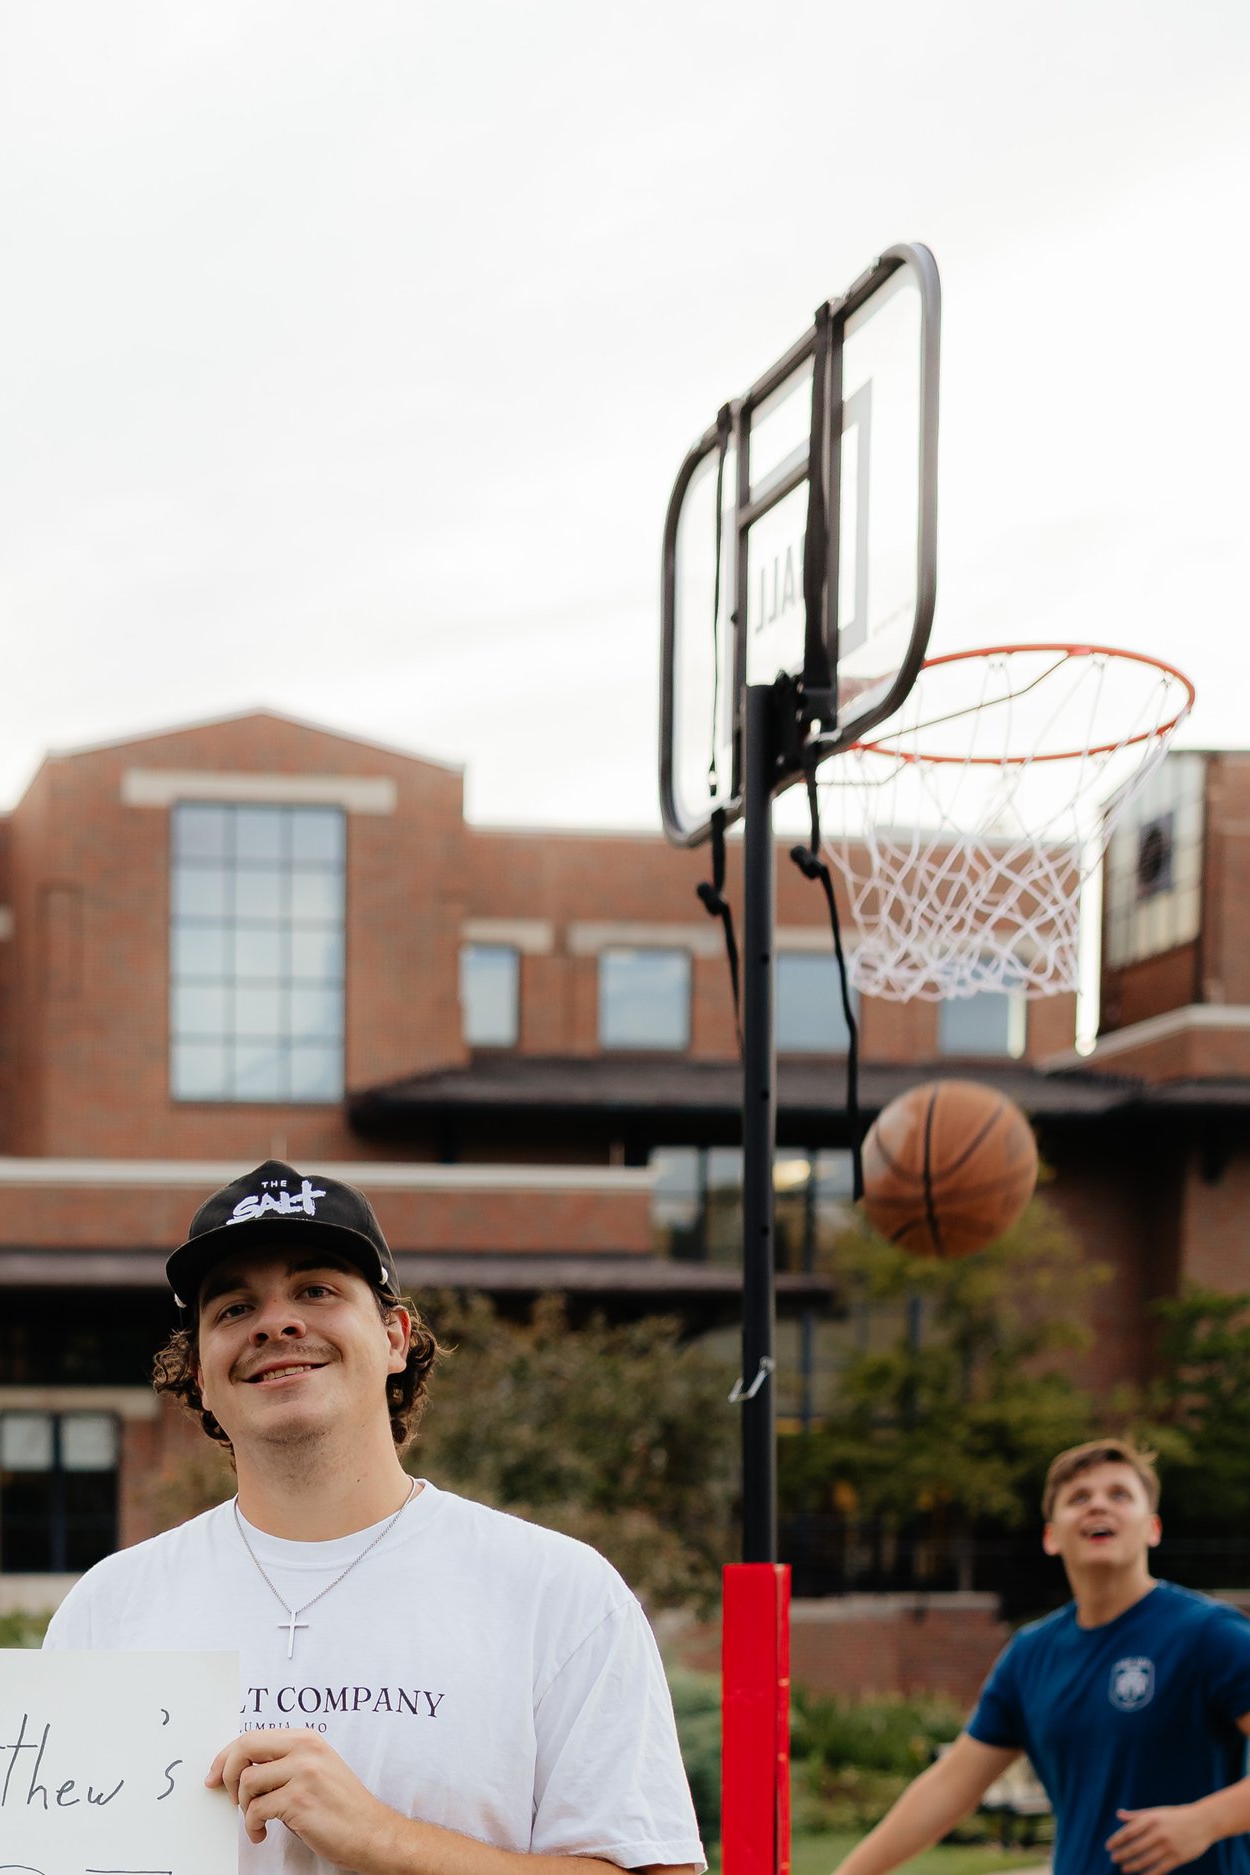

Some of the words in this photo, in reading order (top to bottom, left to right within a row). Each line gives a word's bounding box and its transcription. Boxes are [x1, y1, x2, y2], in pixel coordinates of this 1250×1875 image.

[261, 1179, 288, 1189] THE
[239, 1687, 270, 1714] T
[276, 1686, 446, 1718] COMPANY
